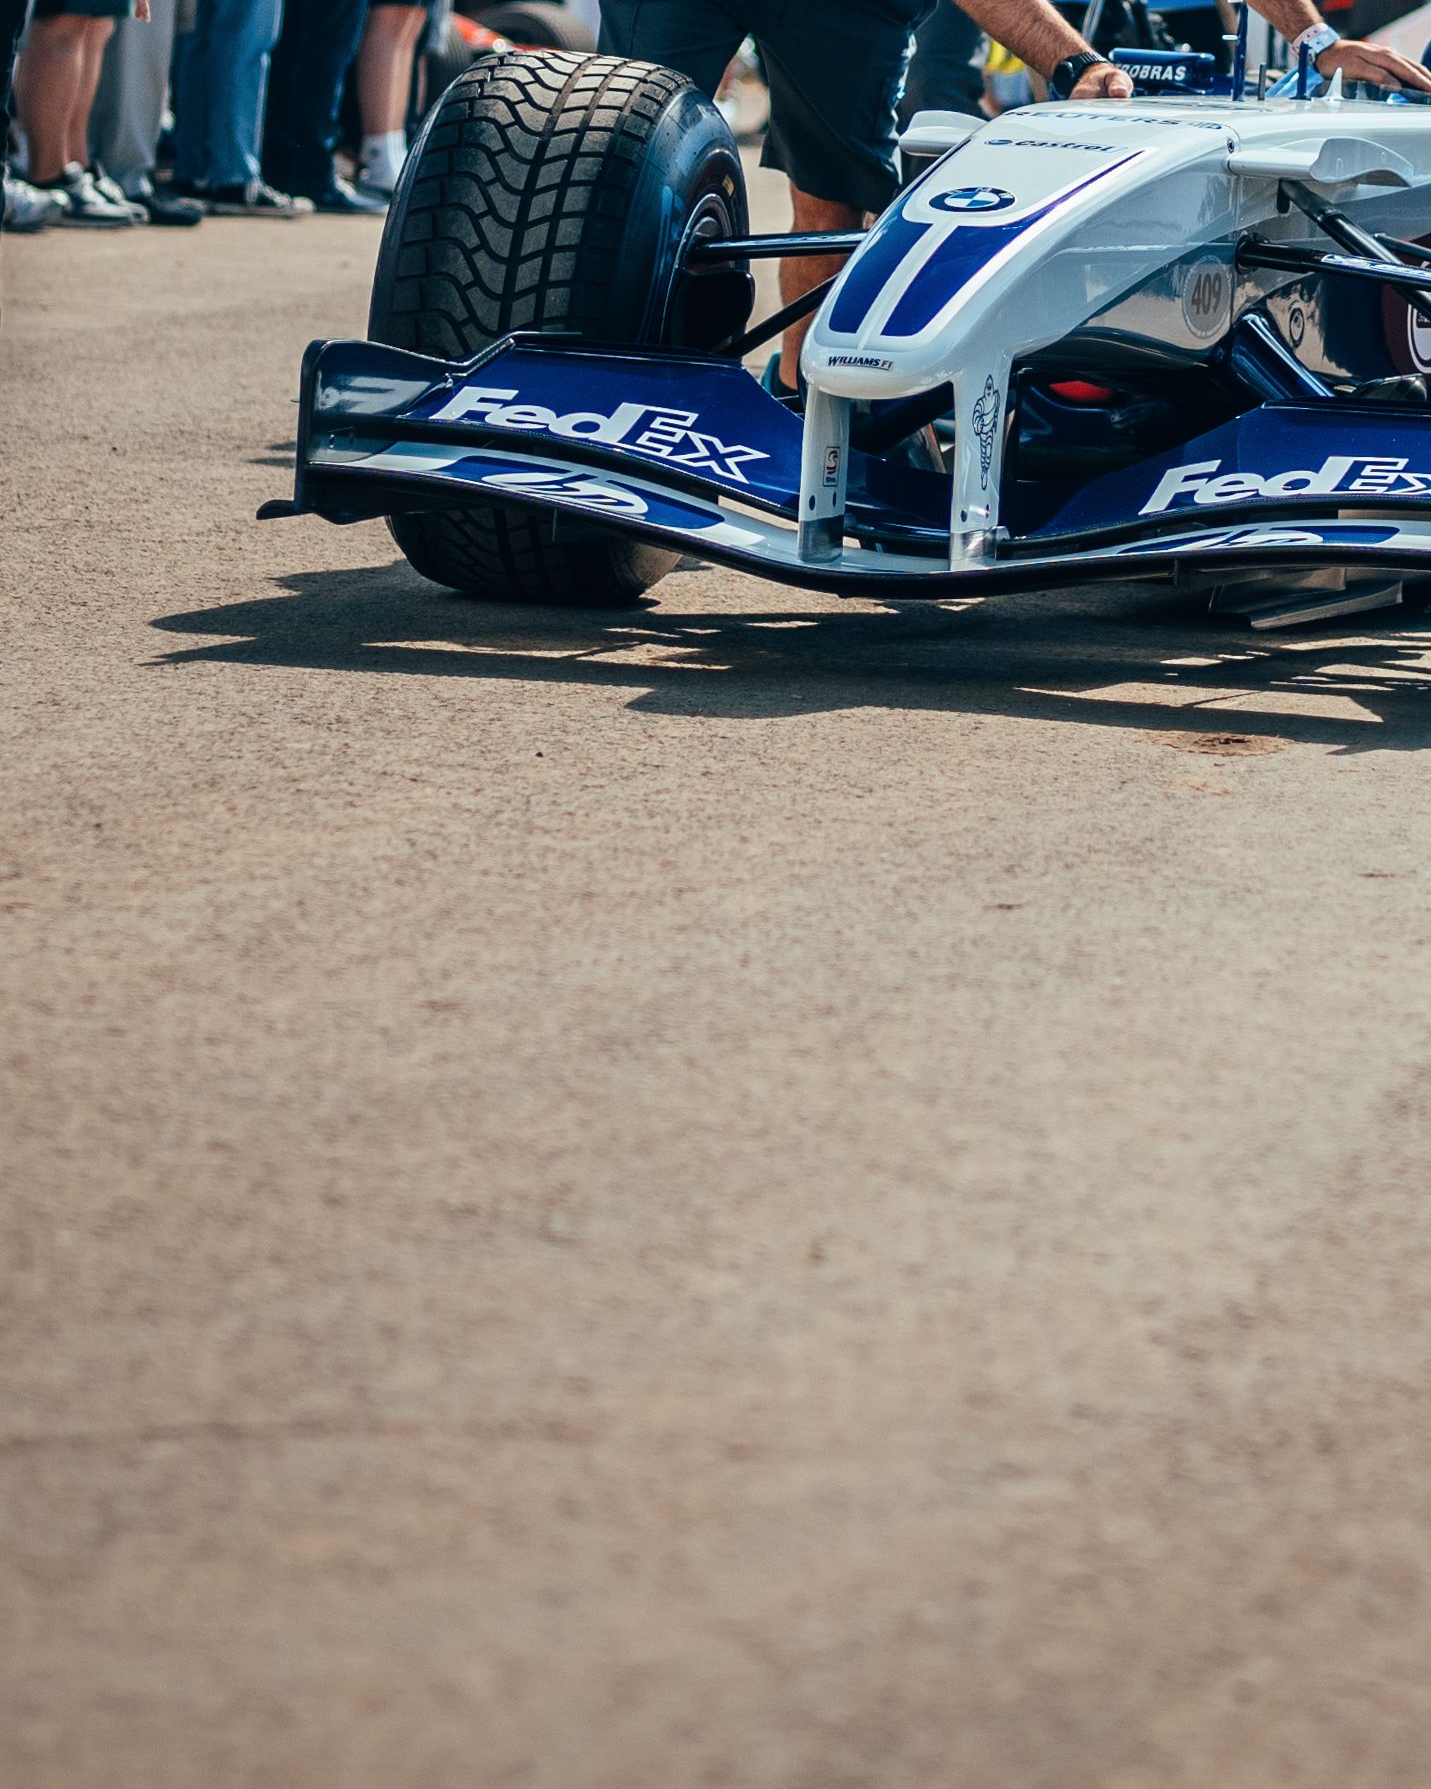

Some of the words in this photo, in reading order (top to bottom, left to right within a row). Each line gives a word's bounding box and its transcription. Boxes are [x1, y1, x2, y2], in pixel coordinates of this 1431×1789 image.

[1014, 140, 1117, 152] Castrol
[1191, 272, 1222, 315] 409
[828, 356, 881, 366] WILLIAMS
[428, 386, 771, 484] FedEx
